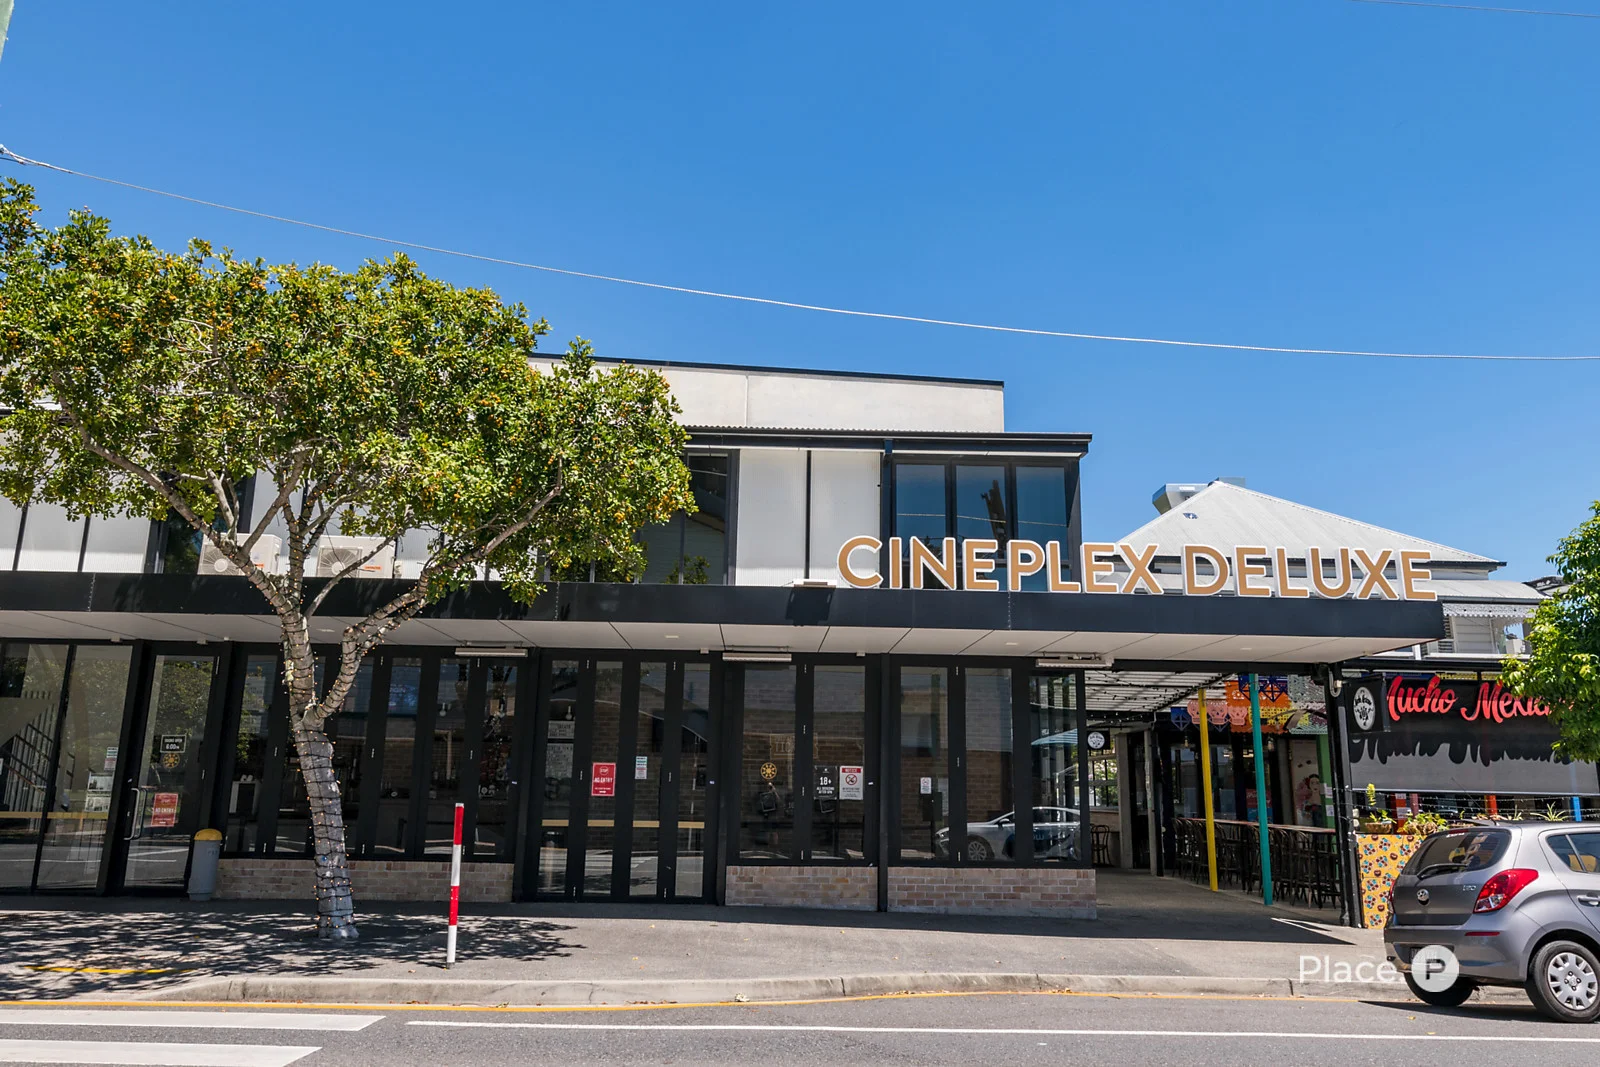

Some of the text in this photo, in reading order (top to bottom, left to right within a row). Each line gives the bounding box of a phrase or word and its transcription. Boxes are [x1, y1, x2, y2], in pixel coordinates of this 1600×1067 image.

[837, 535, 1438, 601] CINEPLEX DELUXE
[819, 776, 832, 785] 18+
